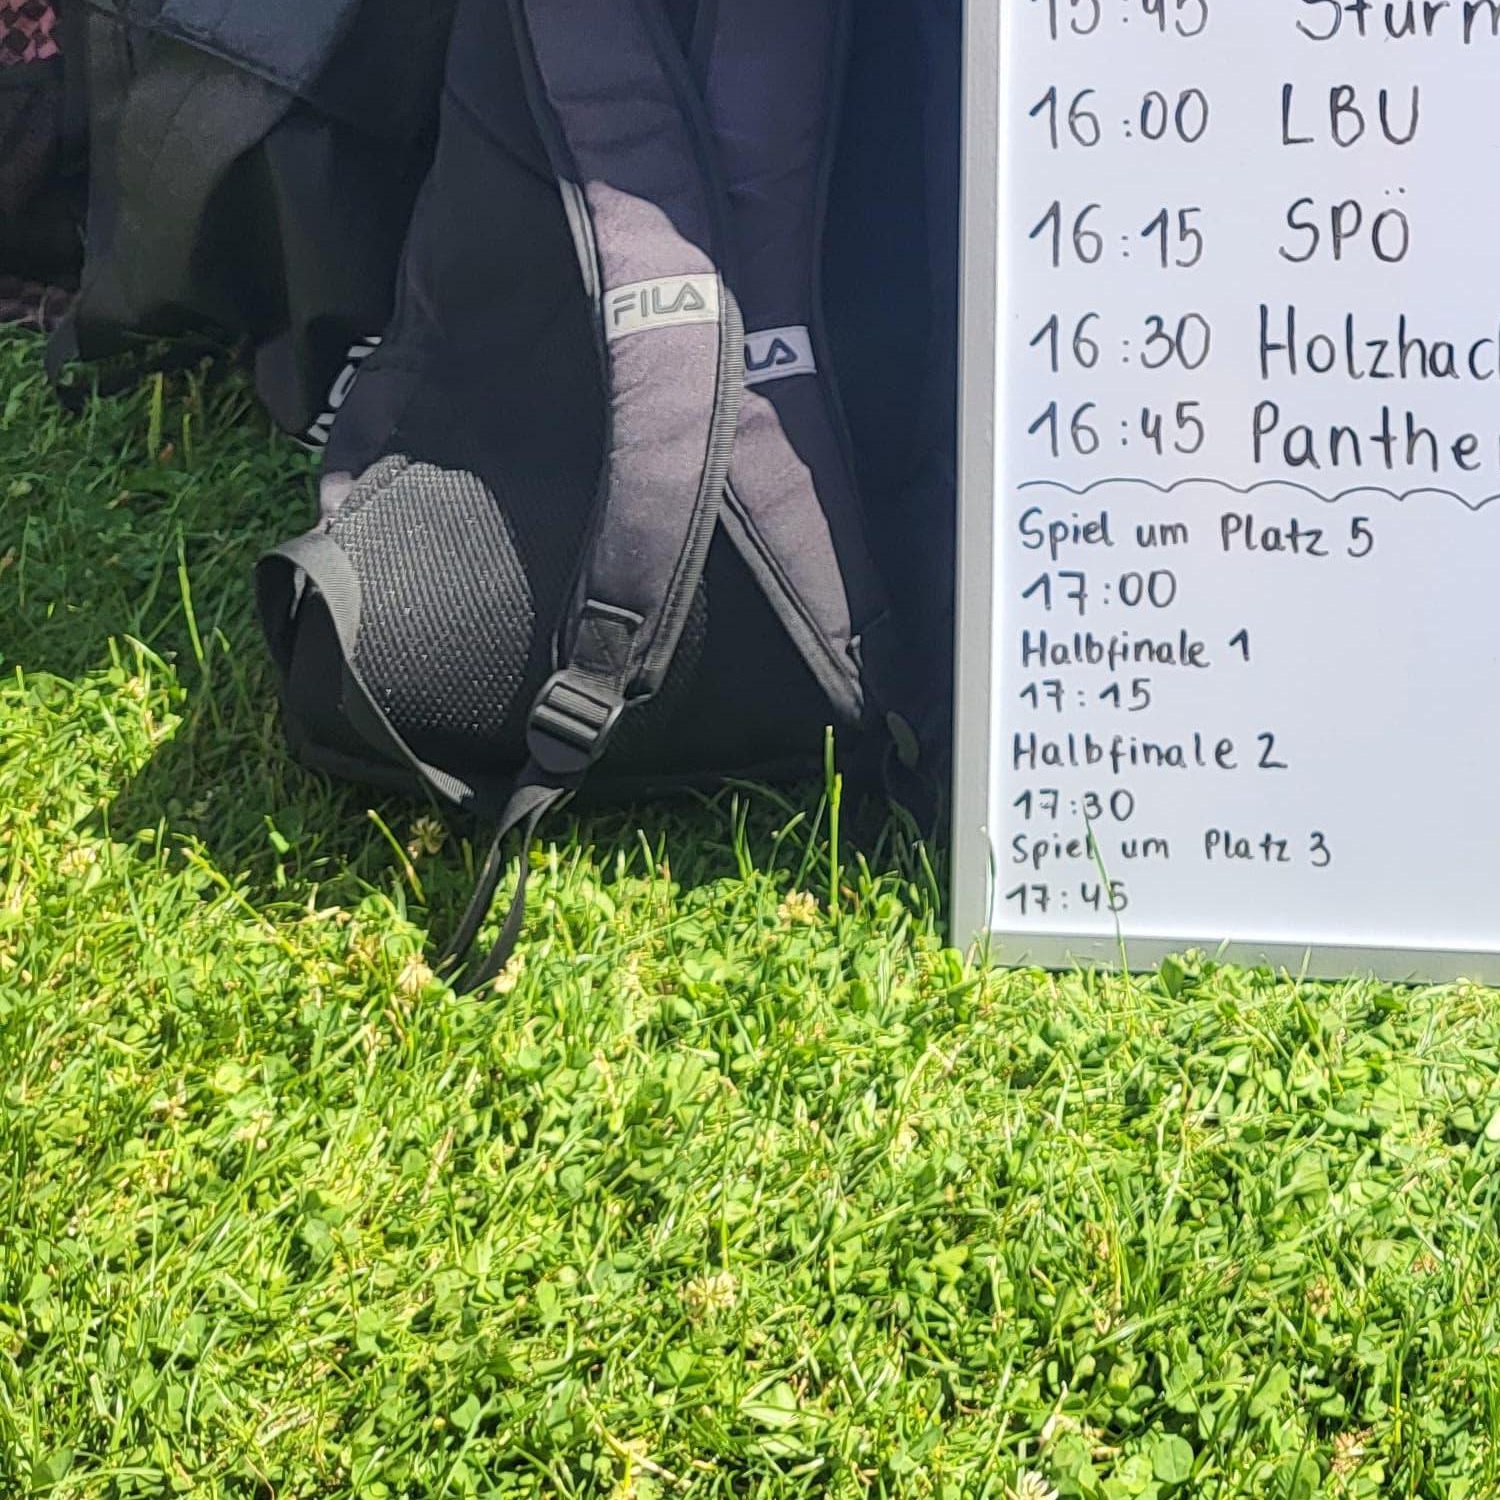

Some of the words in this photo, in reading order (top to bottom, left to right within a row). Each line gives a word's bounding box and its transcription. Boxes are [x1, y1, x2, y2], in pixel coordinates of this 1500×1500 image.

[1029, 85, 1209, 149] 16:00
[1282, 83, 1419, 148] LBU
[1028, 200, 1203, 268] 16:15
[1279, 187, 1409, 263] SPÖ
[613, 282, 705, 326] FILA
[1029, 312, 1211, 373] 16:30
[1028, 401, 1204, 458] 16:45
[1018, 506, 1115, 562] Spiel
[1136, 522, 1188, 548] um
[1220, 512, 1329, 557] Platz
[1347, 516, 1374, 558] 5
[1022, 569, 1177, 616] 17:00
[1022, 629, 1210, 672] Halbfinale
[1228, 628, 1250, 662] 1
[1019, 678, 1151, 713] 17:15
[1013, 732, 1238, 775] Halbfinale
[1257, 732, 1288, 769] 2
[1013, 788, 1135, 822] 17:30
[1012, 830, 1096, 871] Spiel
[1121, 837, 1169, 859] um
[1205, 828, 1290, 862] Platz
[1309, 831, 1331, 867] 3
[1005, 880, 1128, 916] 17:45
